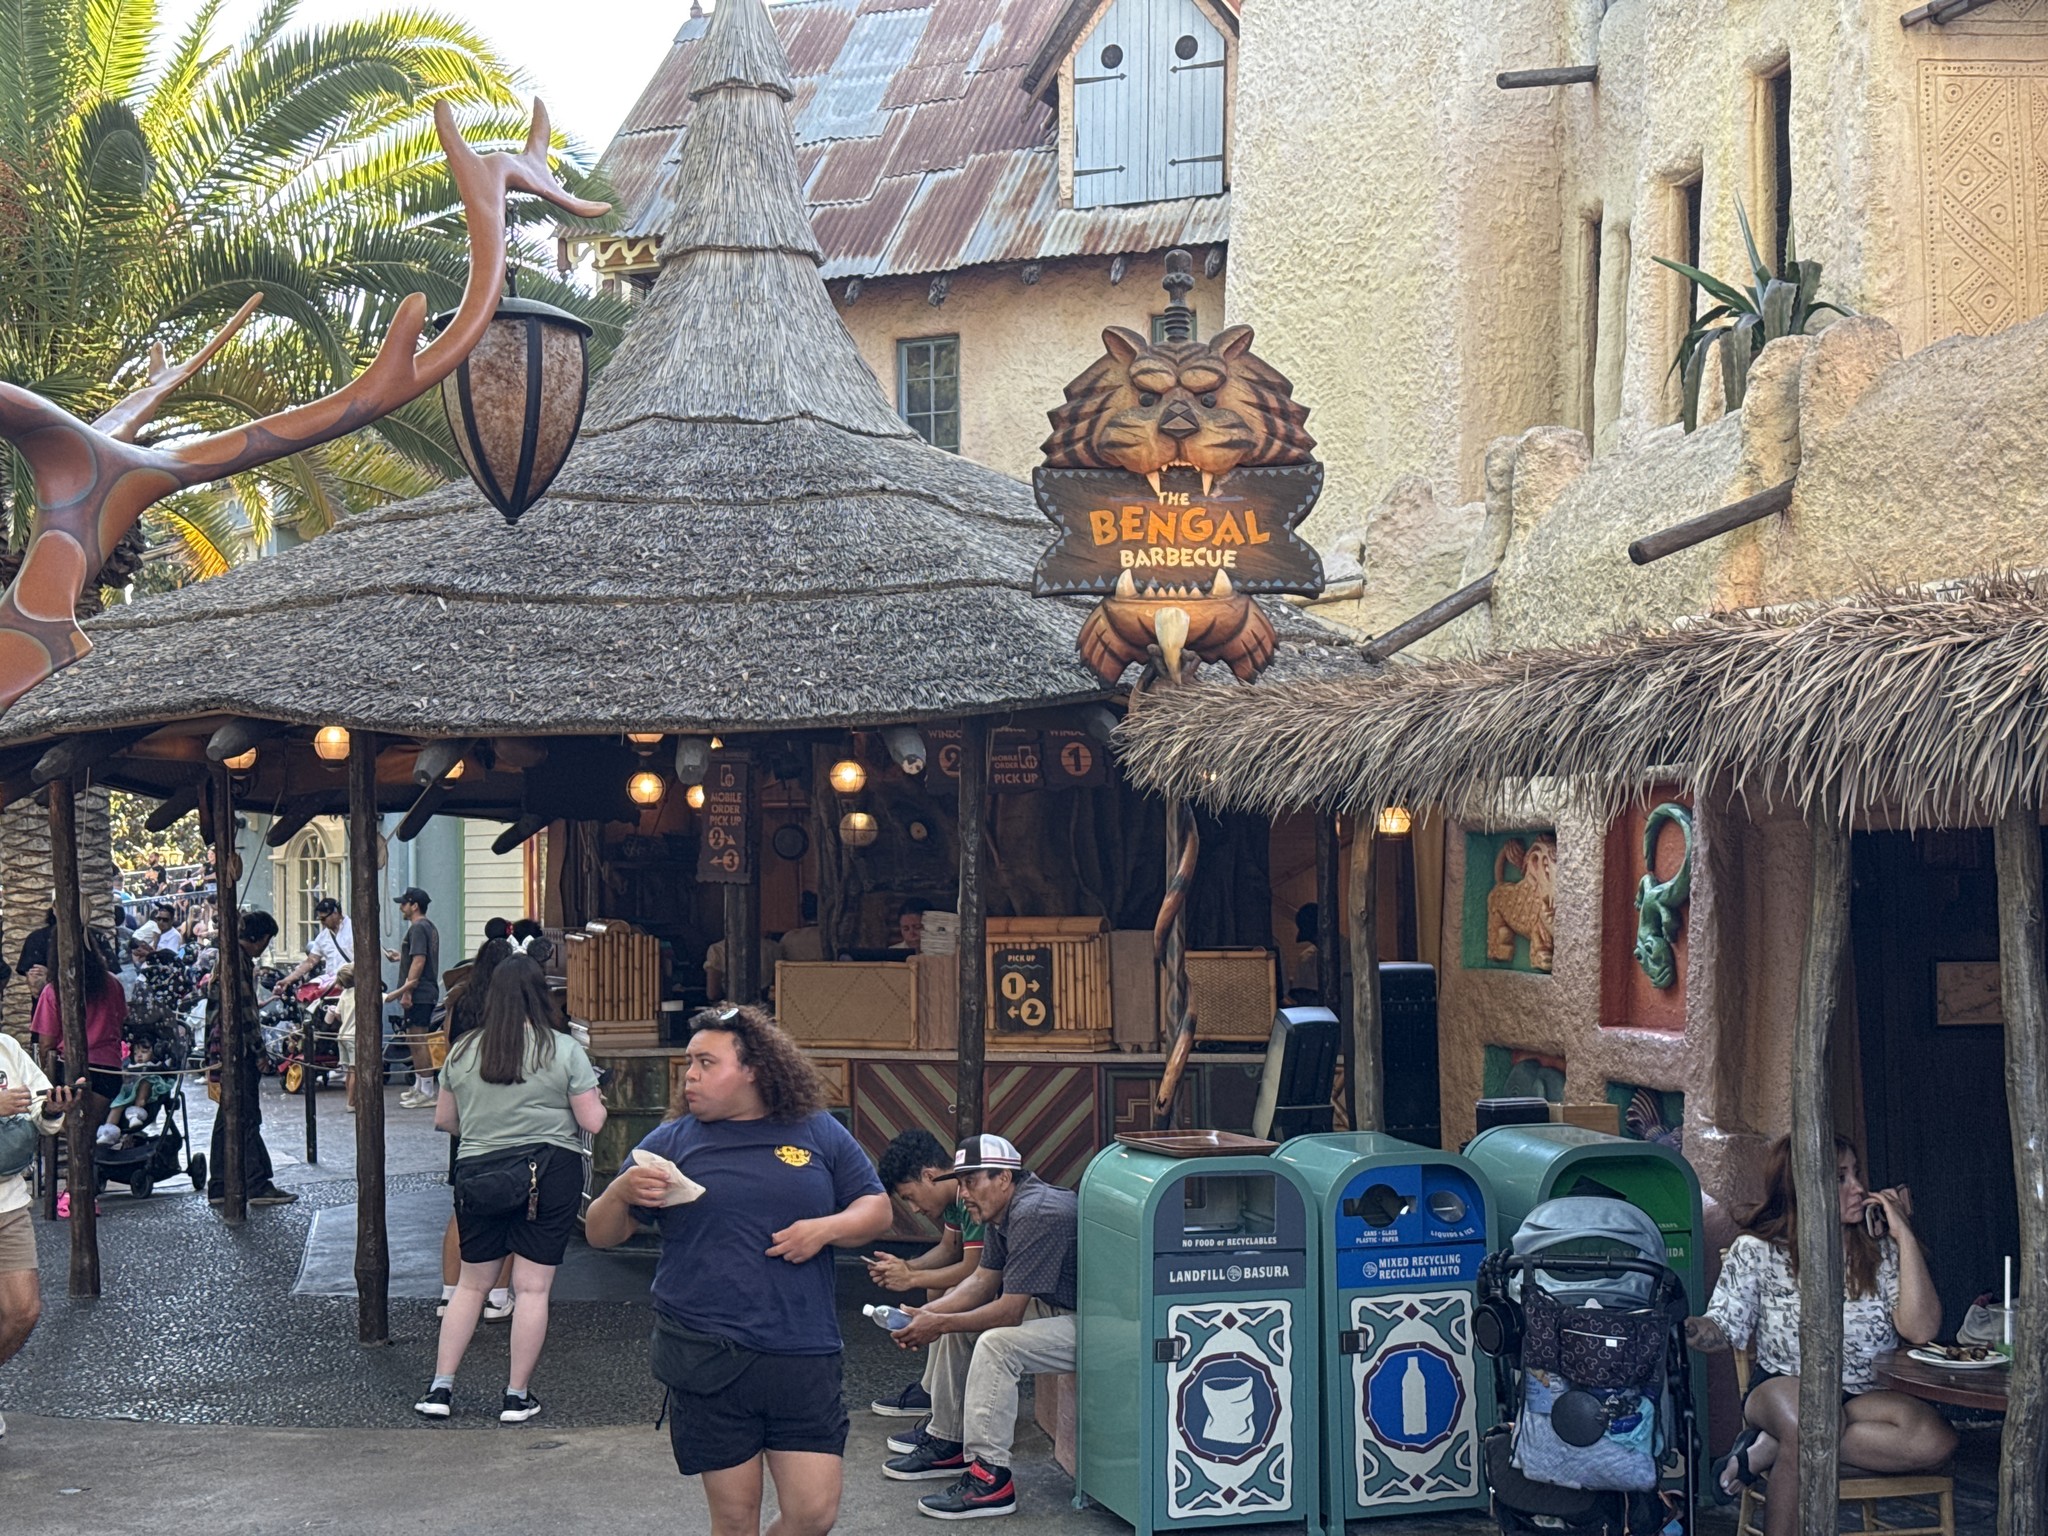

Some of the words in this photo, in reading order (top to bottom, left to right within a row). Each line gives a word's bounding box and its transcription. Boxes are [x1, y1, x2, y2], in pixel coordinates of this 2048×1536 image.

[1158, 492, 1190, 505] THE
[1089, 506, 1270, 546] BENGAL
[1120, 547, 1238, 568] BARBECUE
[1068, 746, 1081, 772] 1
[994, 773, 1020, 784] PICK
[1022, 773, 1038, 784] UP
[710, 792, 742, 802] MOBILE
[711, 804, 740, 814] ORDER
[710, 815, 728, 826] PICK
[730, 815, 742, 826] UP
[1008, 978, 1016, 994] 1
[1026, 1003, 1040, 1019] 2
[1430, 1230, 1458, 1238] LIQUIDS
[1182, 1239, 1192, 1247] NO
[1195, 1238, 1215, 1247] FOOD
[1226, 1236, 1277, 1246] RECYCLABLES
[1379, 1258, 1409, 1268] MIXED
[1412, 1254, 1461, 1267] RECYCLING
[1169, 1268, 1226, 1283] LANDFILL
[1243, 1265, 1289, 1279] BASURA
[1379, 1268, 1427, 1280] RECICLAJA
[1430, 1266, 1460, 1276] MIXTO
